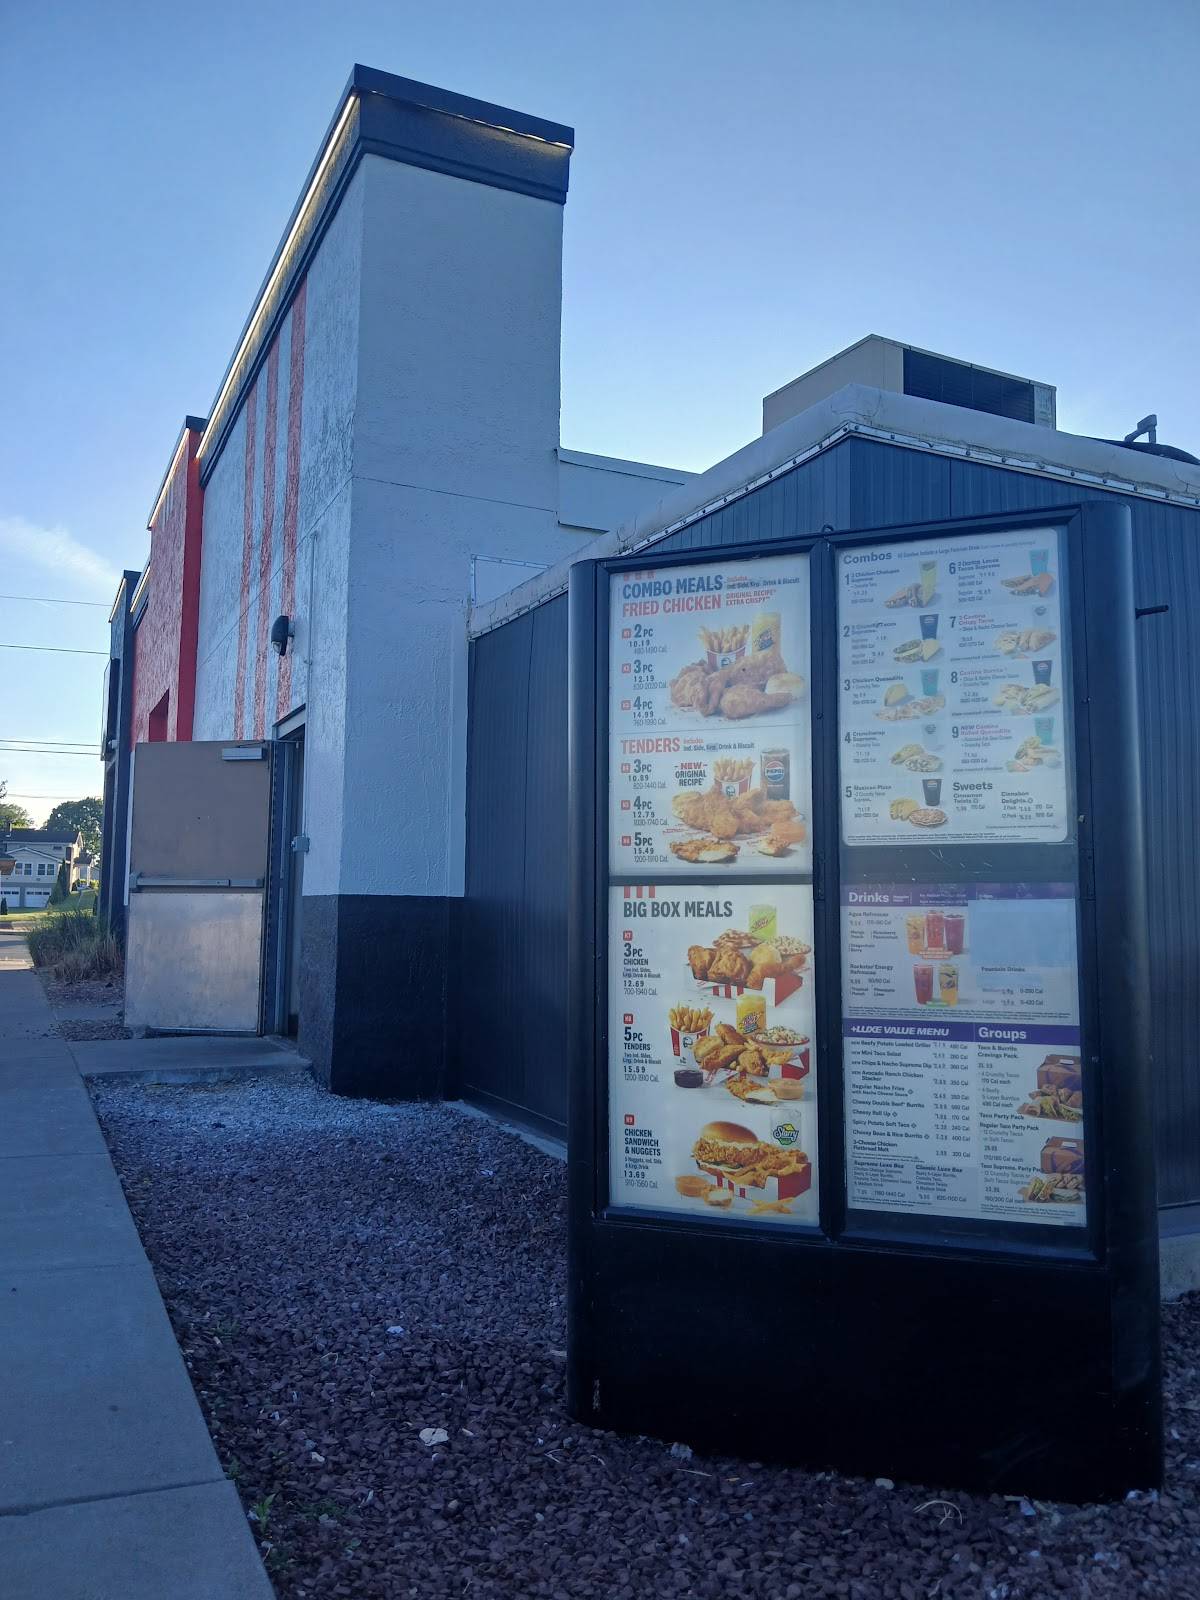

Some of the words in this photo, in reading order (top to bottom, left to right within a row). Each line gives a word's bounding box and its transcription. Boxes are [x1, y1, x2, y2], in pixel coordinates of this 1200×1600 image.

[843, 551, 892, 565] Combos
[949, 562, 956, 575] 6
[844, 573, 850, 585] 1
[623, 580, 672, 599] COMBO
[676, 574, 724, 594] MEALS
[622, 600, 659, 617] FRIED
[663, 594, 722, 613] CHICKEN
[949, 616, 956, 628] 7
[843, 625, 850, 637] 2
[951, 671, 958, 683] 8
[844, 679, 850, 691] 3
[844, 732, 851, 744] 4
[952, 726, 959, 738] 9
[621, 736, 680, 754] TENDERS
[680, 761, 702, 770] NEW
[675, 770, 707, 778] ORIGINAL
[845, 786, 852, 798] 5
[952, 781, 993, 791] Sweets
[848, 892, 889, 903] Drinks
[624, 902, 647, 917] BIG
[651, 902, 680, 917] BOX
[685, 901, 733, 917] MEALS
[884, 1026, 916, 1035] VALUE
[917, 1028, 950, 1036] MENU
[978, 1027, 1027, 1041] Groups
[624, 1042, 651, 1051] TENDERS
[624, 1128, 652, 1137] CHICKEN
[773, 1125, 799, 1141] Starry
[624, 1137, 659, 1147] SANDWICH
[631, 1147, 661, 1156] NUGGETS
[624, 1170, 645, 1178] 13.69
